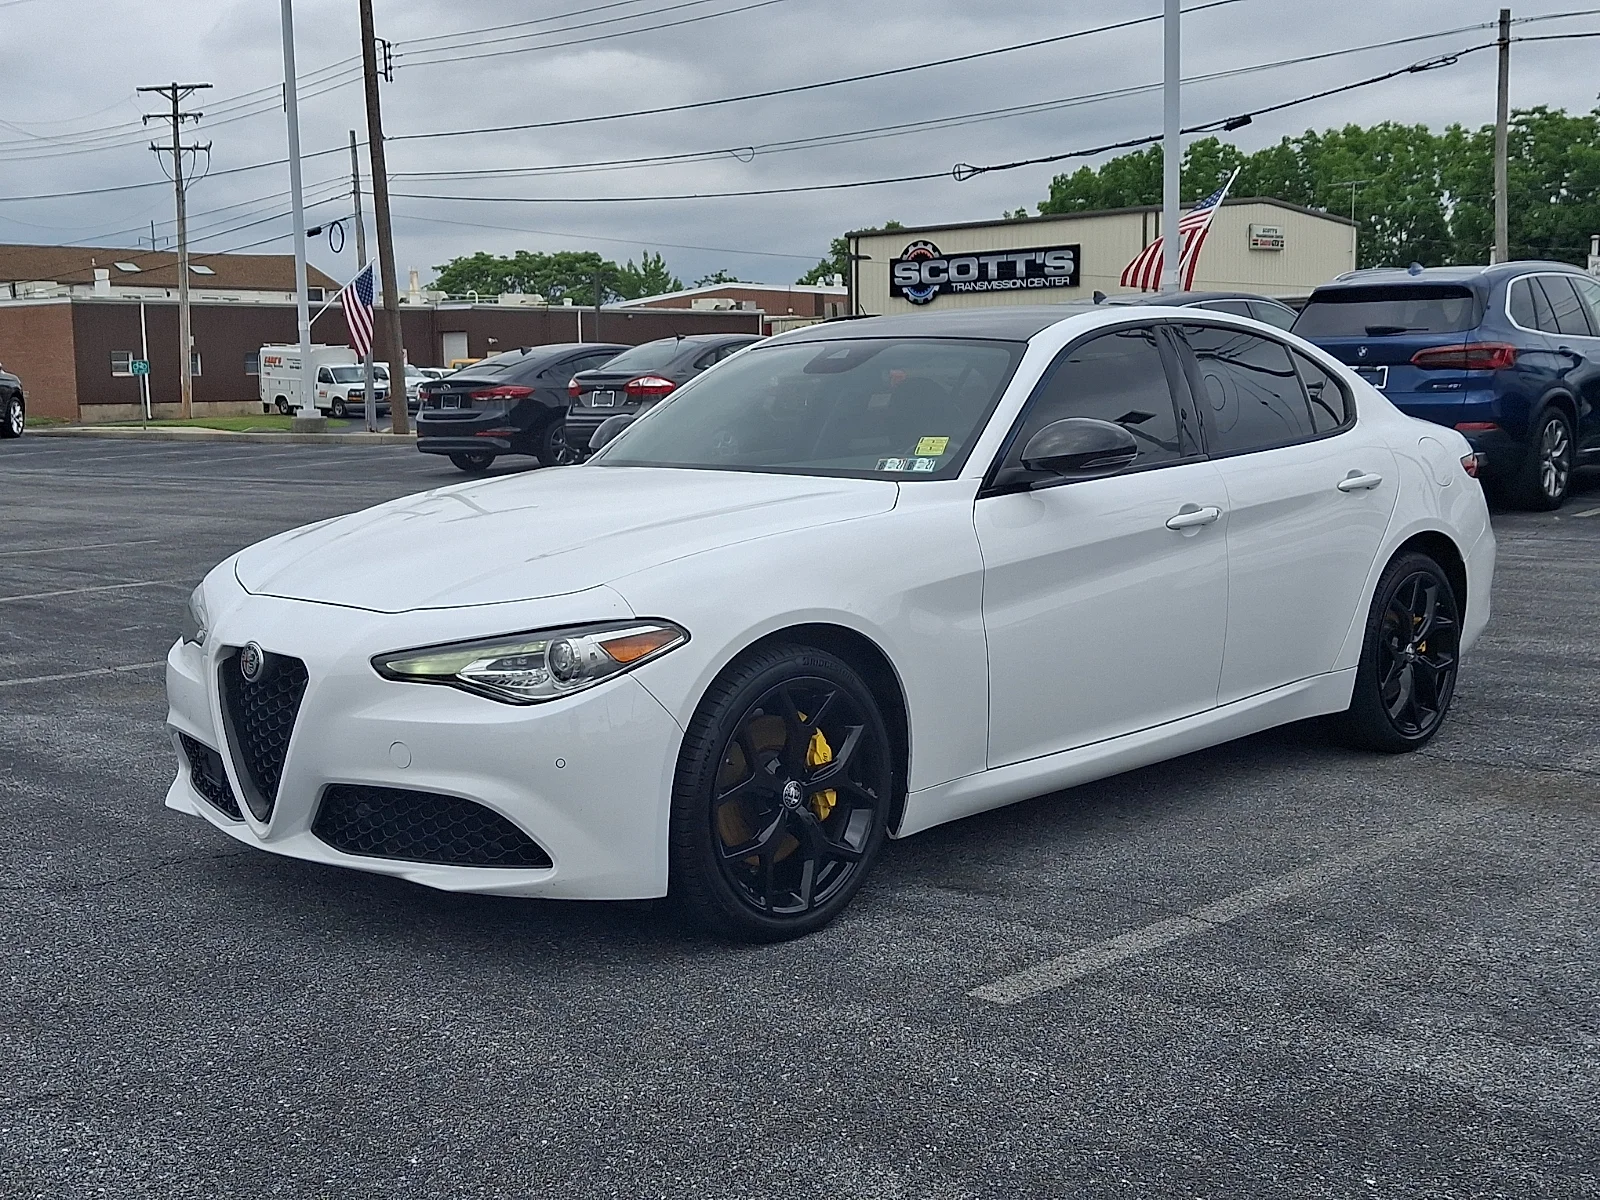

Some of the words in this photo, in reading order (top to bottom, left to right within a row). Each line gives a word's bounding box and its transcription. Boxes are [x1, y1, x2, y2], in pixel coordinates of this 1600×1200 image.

[894, 250, 1075, 286] SCOTT'S
[951, 278, 1027, 292] TRANSMISSION
[1028, 276, 1070, 287] CENTER
